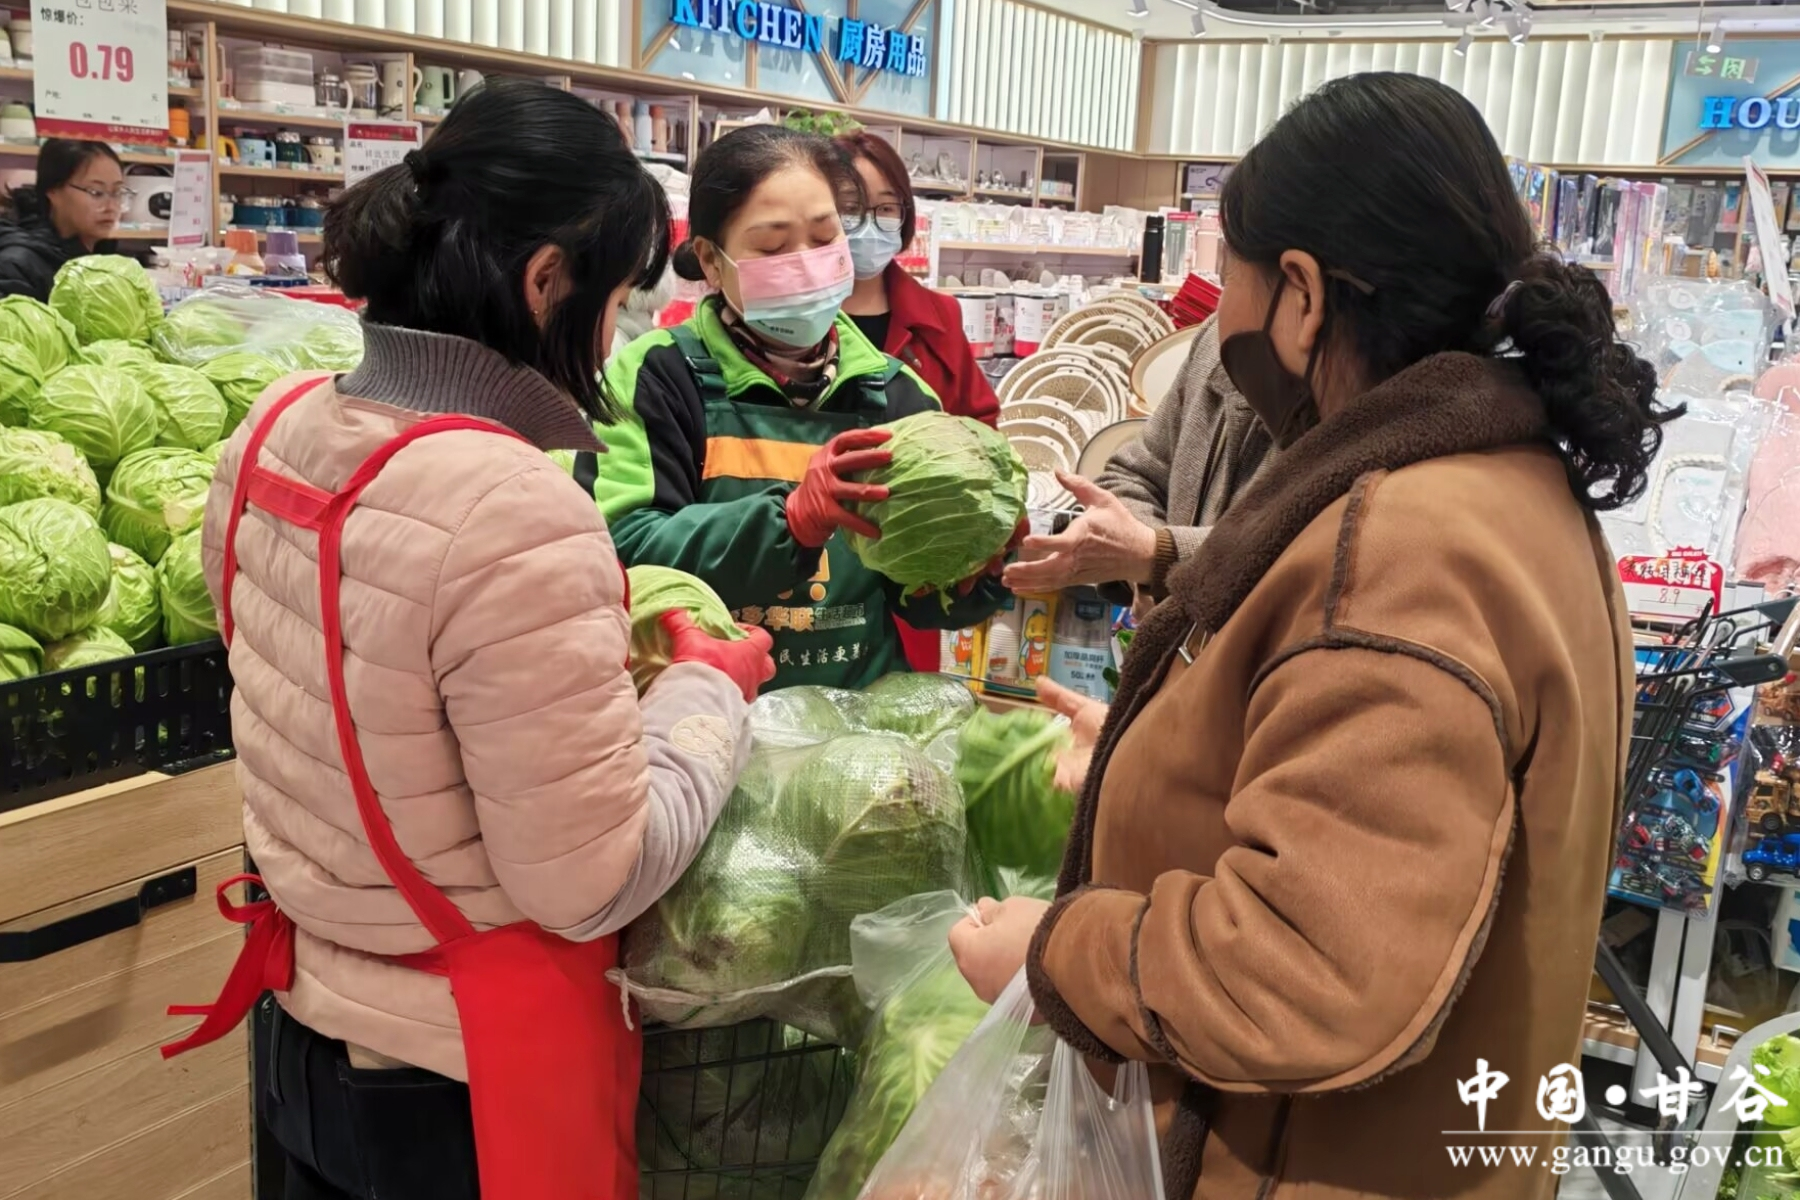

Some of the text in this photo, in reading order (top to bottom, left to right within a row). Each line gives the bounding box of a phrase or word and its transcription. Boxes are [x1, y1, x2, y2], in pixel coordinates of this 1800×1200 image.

[672, 0, 825, 53] KITCHEN
[838, 17, 927, 77] 厨房用品
[69, 41, 134, 83] 0.79
